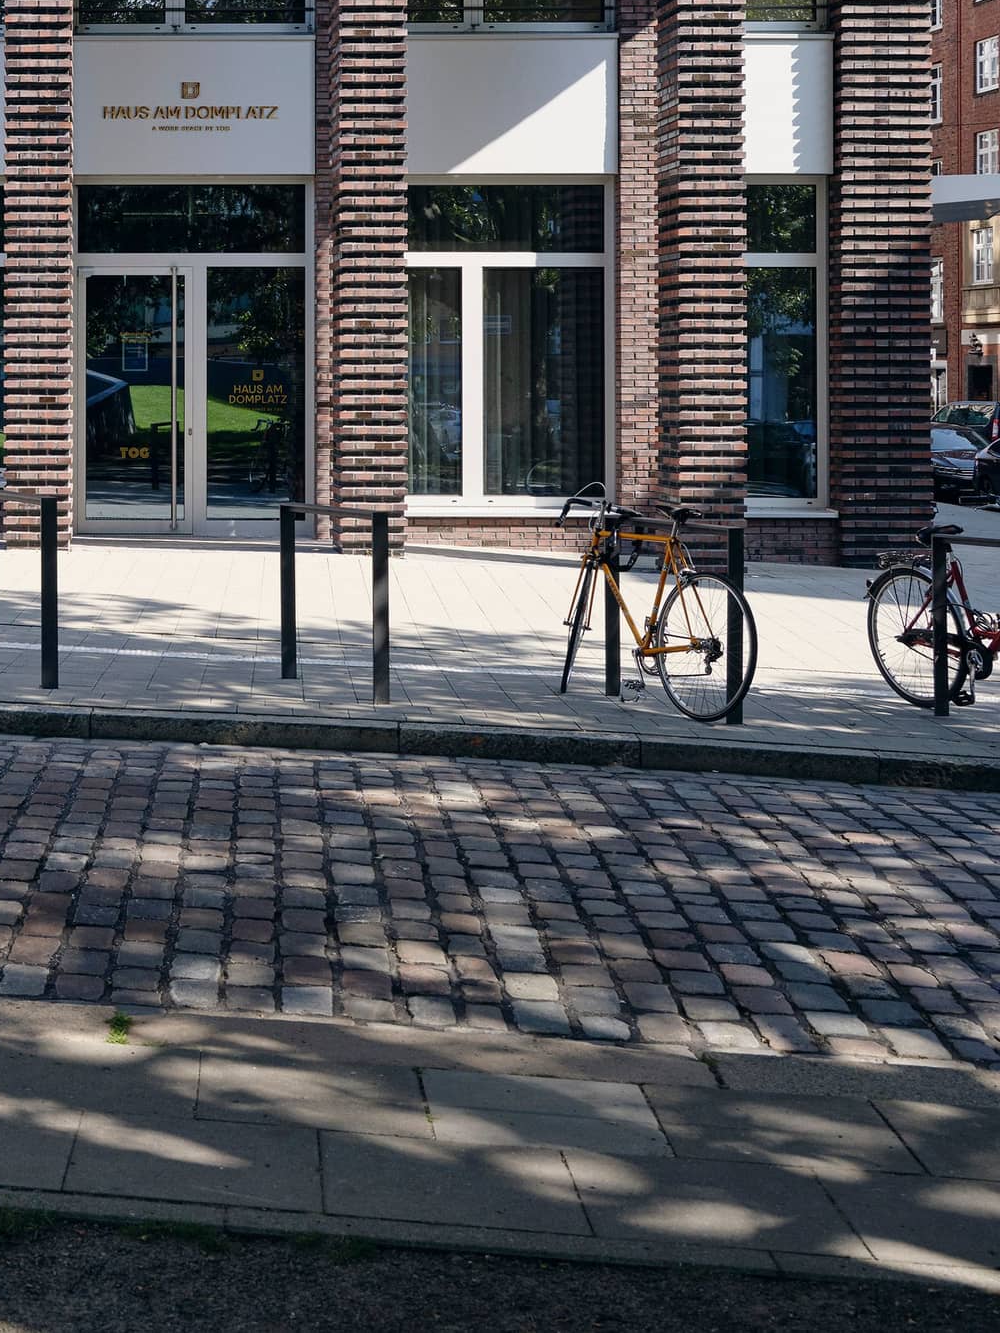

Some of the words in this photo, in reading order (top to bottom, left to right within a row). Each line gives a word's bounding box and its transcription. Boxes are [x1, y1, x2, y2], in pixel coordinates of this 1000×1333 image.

[103, 106, 150, 120] HAUS
[153, 106, 181, 120] AM
[185, 106, 279, 120] DOMPLATZ
[233, 385, 263, 394] HAUS
[266, 385, 283, 394] AM
[229, 395, 288, 404] DOMPLATZ
[119, 447, 150, 458] TOG
